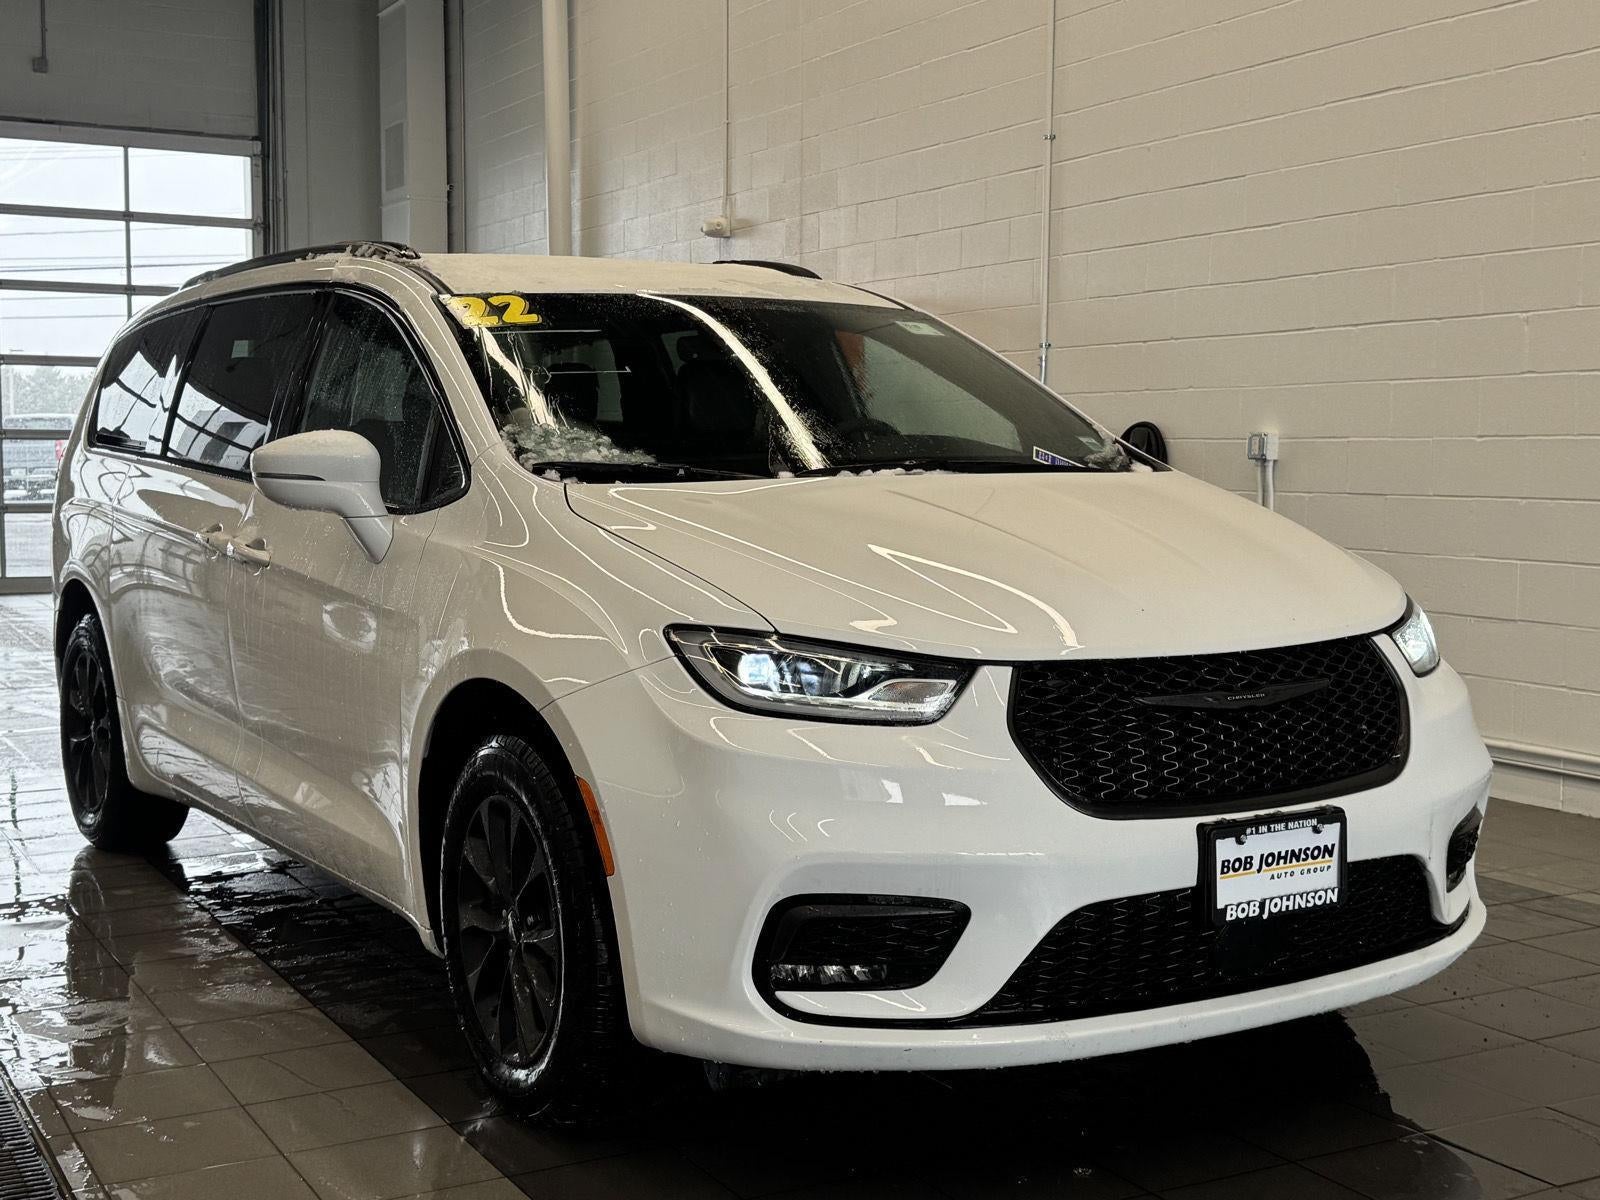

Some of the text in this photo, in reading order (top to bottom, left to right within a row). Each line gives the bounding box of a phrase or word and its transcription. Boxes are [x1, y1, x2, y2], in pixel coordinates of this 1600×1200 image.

[1245, 818, 1318, 836] #1 IN THE NATION
[1220, 843, 1336, 875] BOB JOHNSON
[1269, 865, 1332, 880] AUTO GROUP
[1225, 888, 1339, 921] BOB JOHNSON
